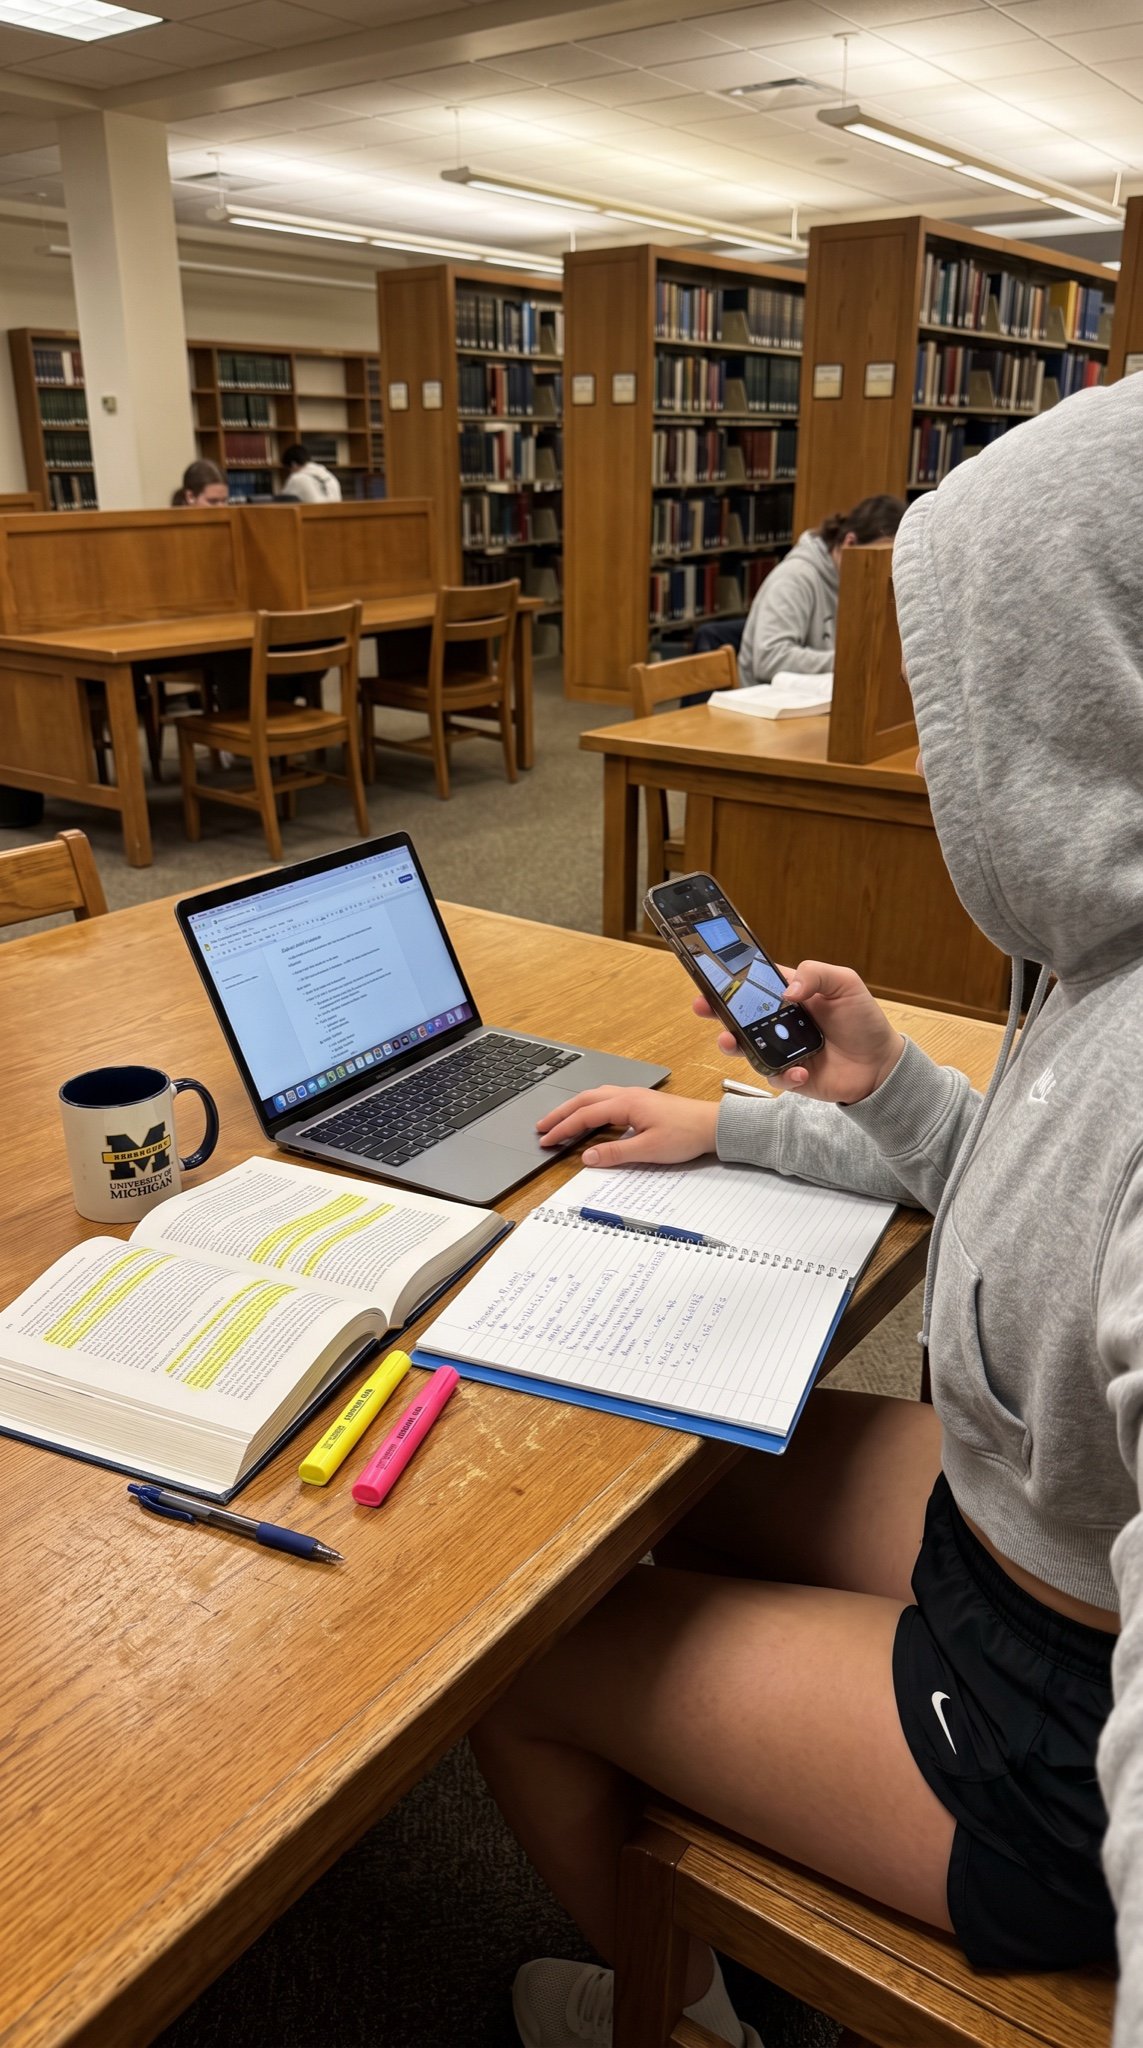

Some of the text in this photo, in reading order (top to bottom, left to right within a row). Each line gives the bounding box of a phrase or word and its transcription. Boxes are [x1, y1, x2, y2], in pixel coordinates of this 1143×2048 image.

[106, 1121, 169, 1180] M
[164, 1168, 172, 1177] OF
[110, 1175, 173, 1199] MICHIGAN
